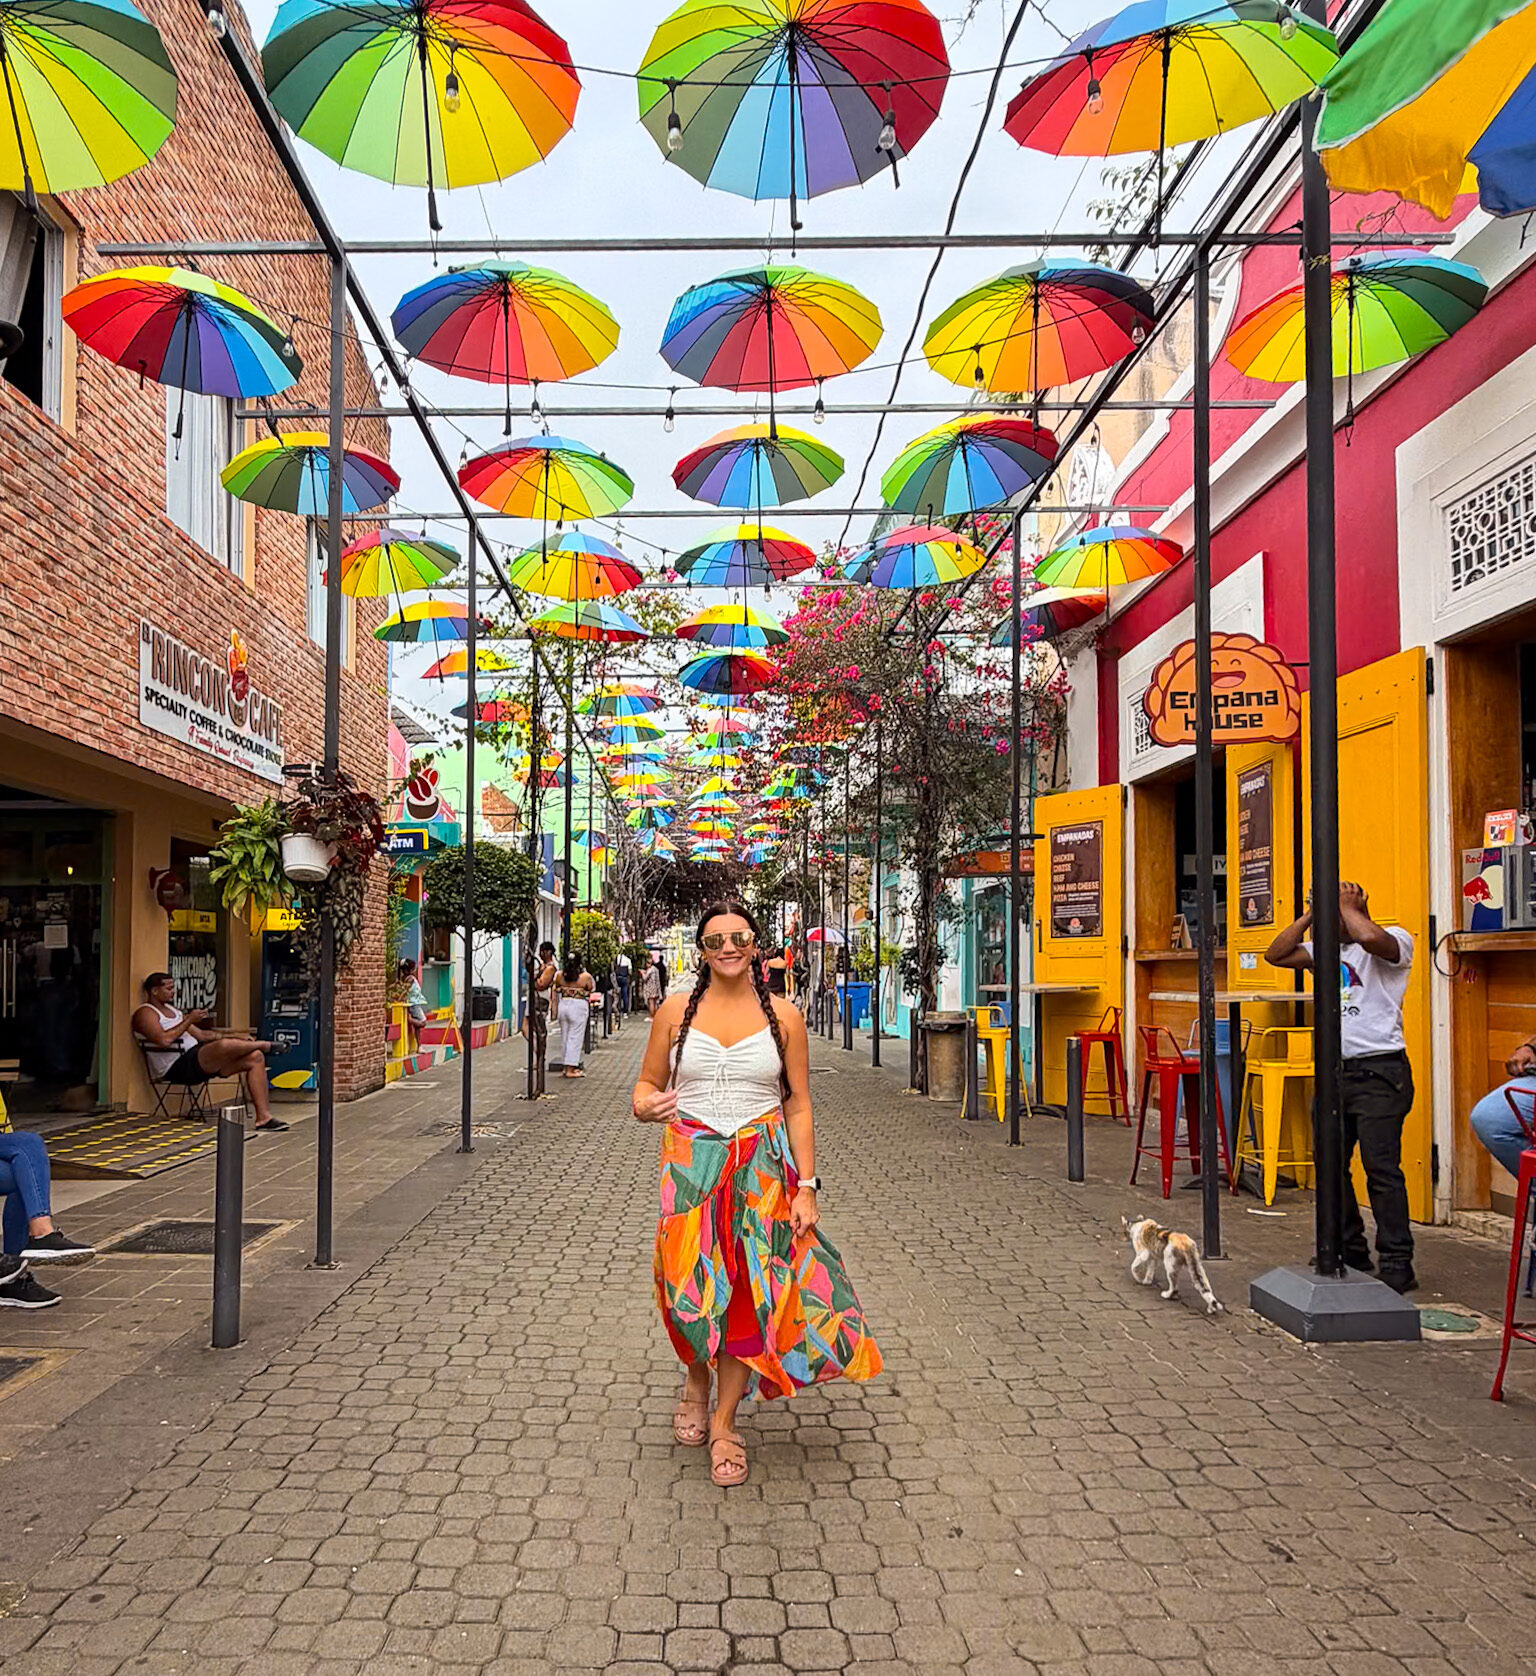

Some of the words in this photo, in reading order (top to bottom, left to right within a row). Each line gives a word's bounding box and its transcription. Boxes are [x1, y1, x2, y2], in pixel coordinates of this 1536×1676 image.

[152, 629, 229, 717] RINCON
[145, 686, 187, 720] SPECIALTY
[189, 709, 217, 735] COFFEE
[218, 724, 224, 738] &
[225, 728, 264, 758] CHOCOLATE
[1057, 830, 1095, 843] EMPANADAS
[390, 837, 414, 849] ATM
[1465, 852, 1481, 864] Red
[1078, 881, 1100, 890] CHEESE
